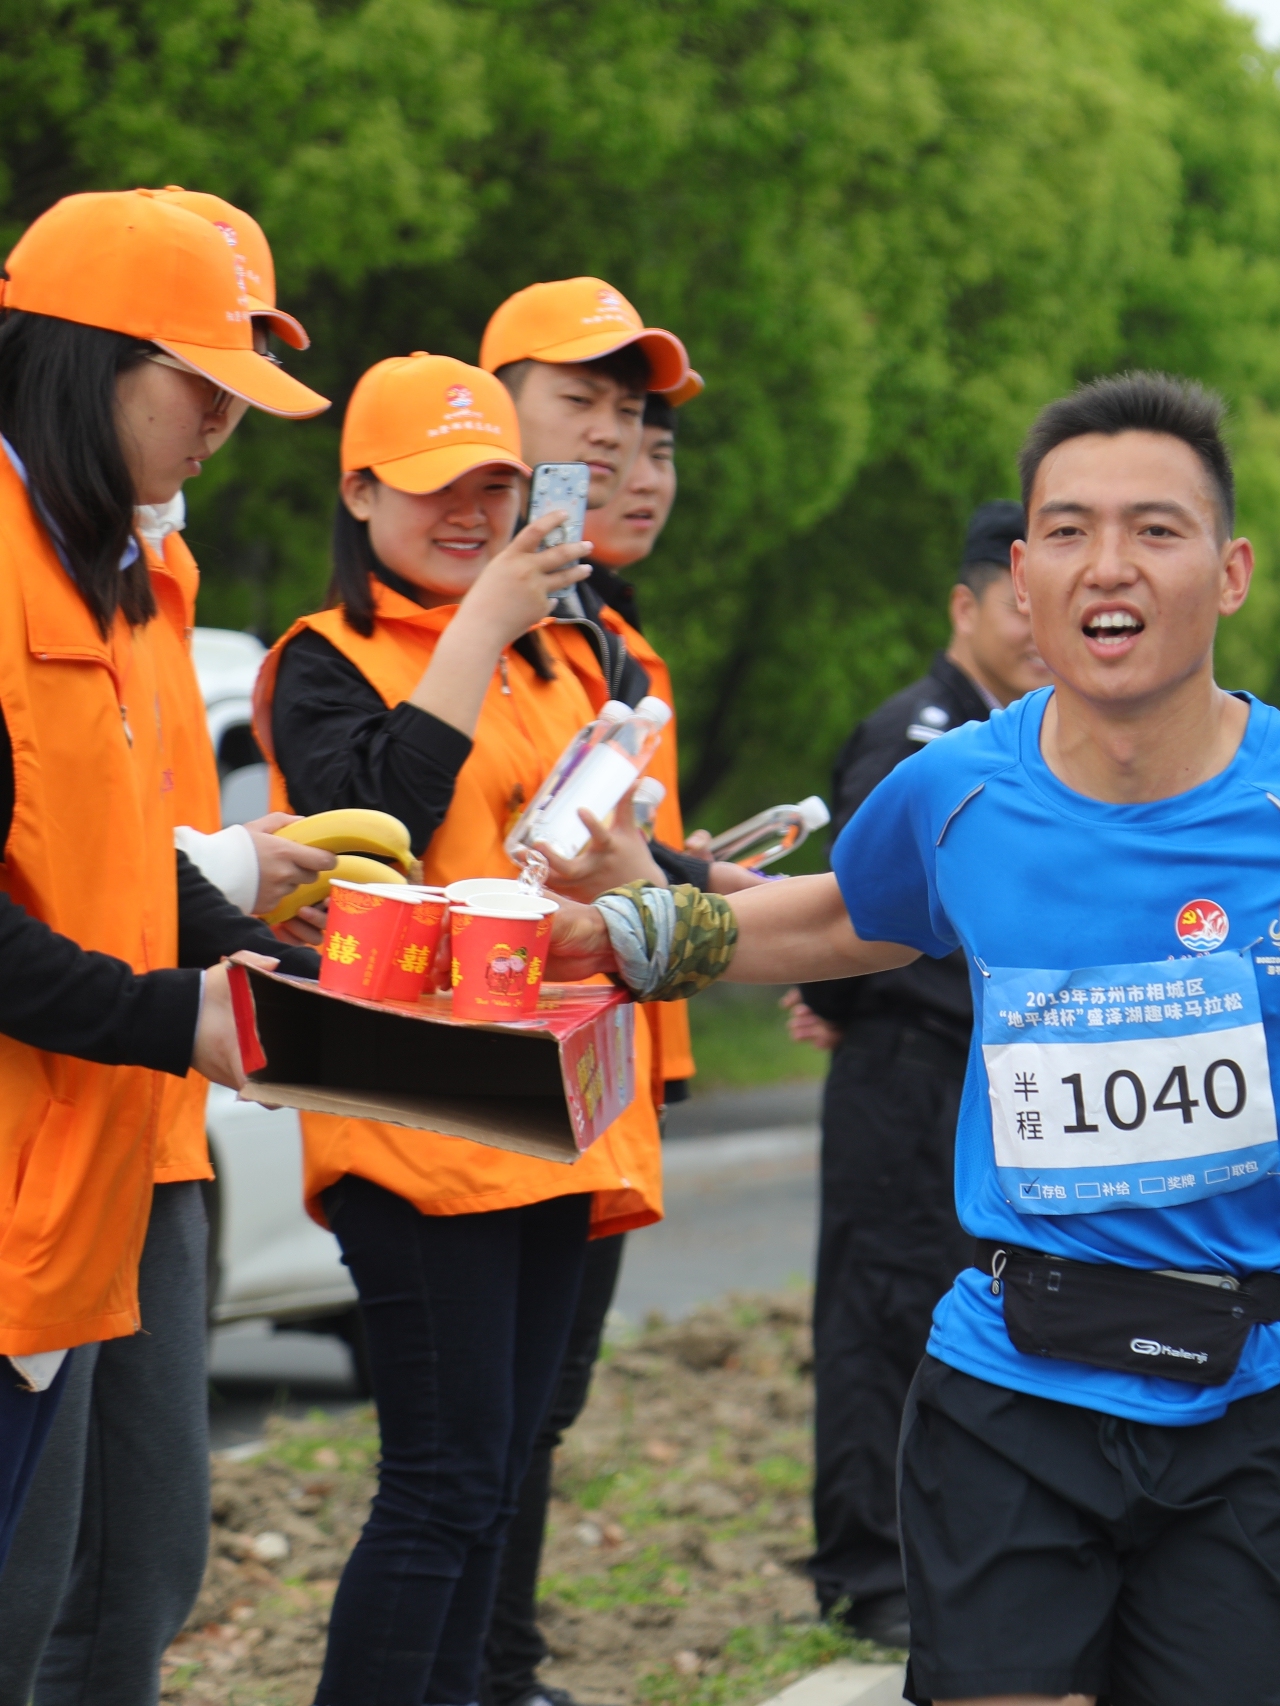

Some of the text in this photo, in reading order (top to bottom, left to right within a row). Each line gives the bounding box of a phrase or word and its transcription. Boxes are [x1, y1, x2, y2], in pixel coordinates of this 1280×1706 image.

[1026, 978, 1206, 1008] 2019年苏州市相城区
[1013, 1071, 1044, 1140] 半程
[1060, 1058, 1247, 1134] 1040
[1042, 1160, 1259, 1199] 存包 补给 奖牌 取包
